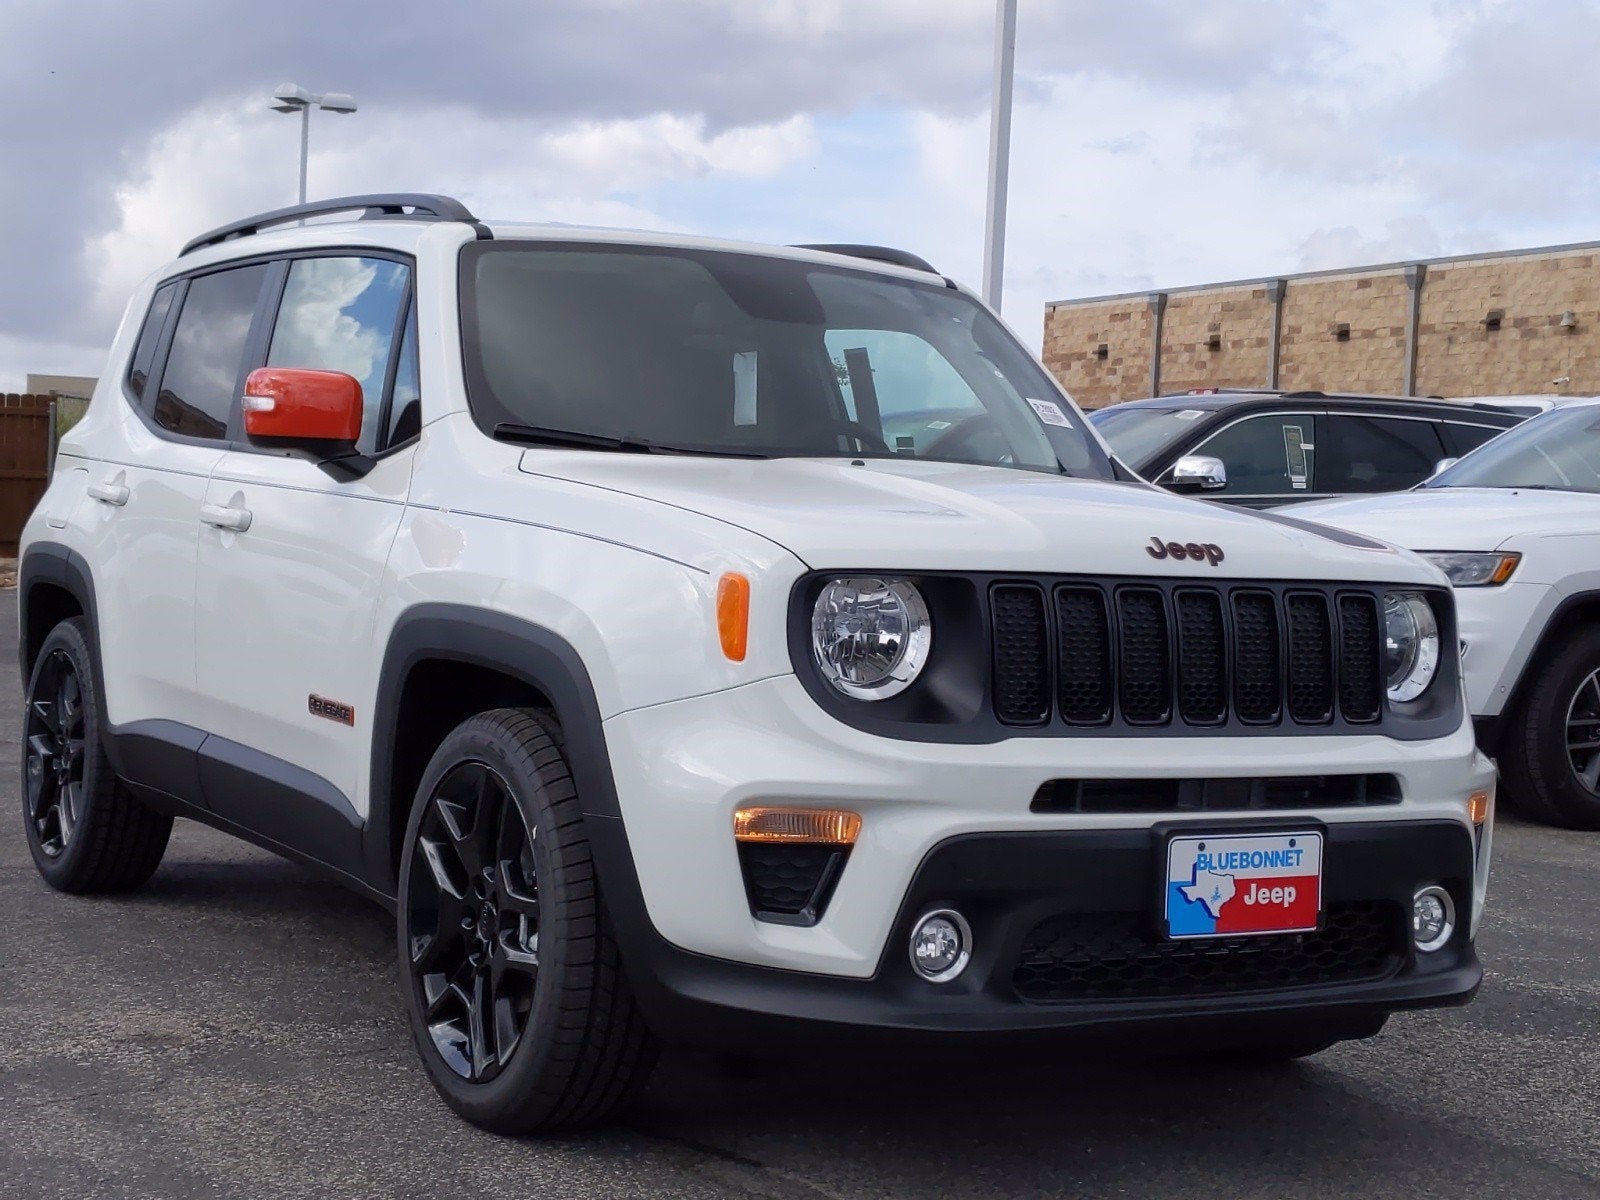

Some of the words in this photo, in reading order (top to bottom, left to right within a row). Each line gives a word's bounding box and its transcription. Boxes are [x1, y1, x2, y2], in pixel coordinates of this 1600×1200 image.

[1145, 536, 1225, 567] Jeep
[1197, 850, 1303, 871] BLUEBONNET
[1244, 884, 1296, 907] Jeep
